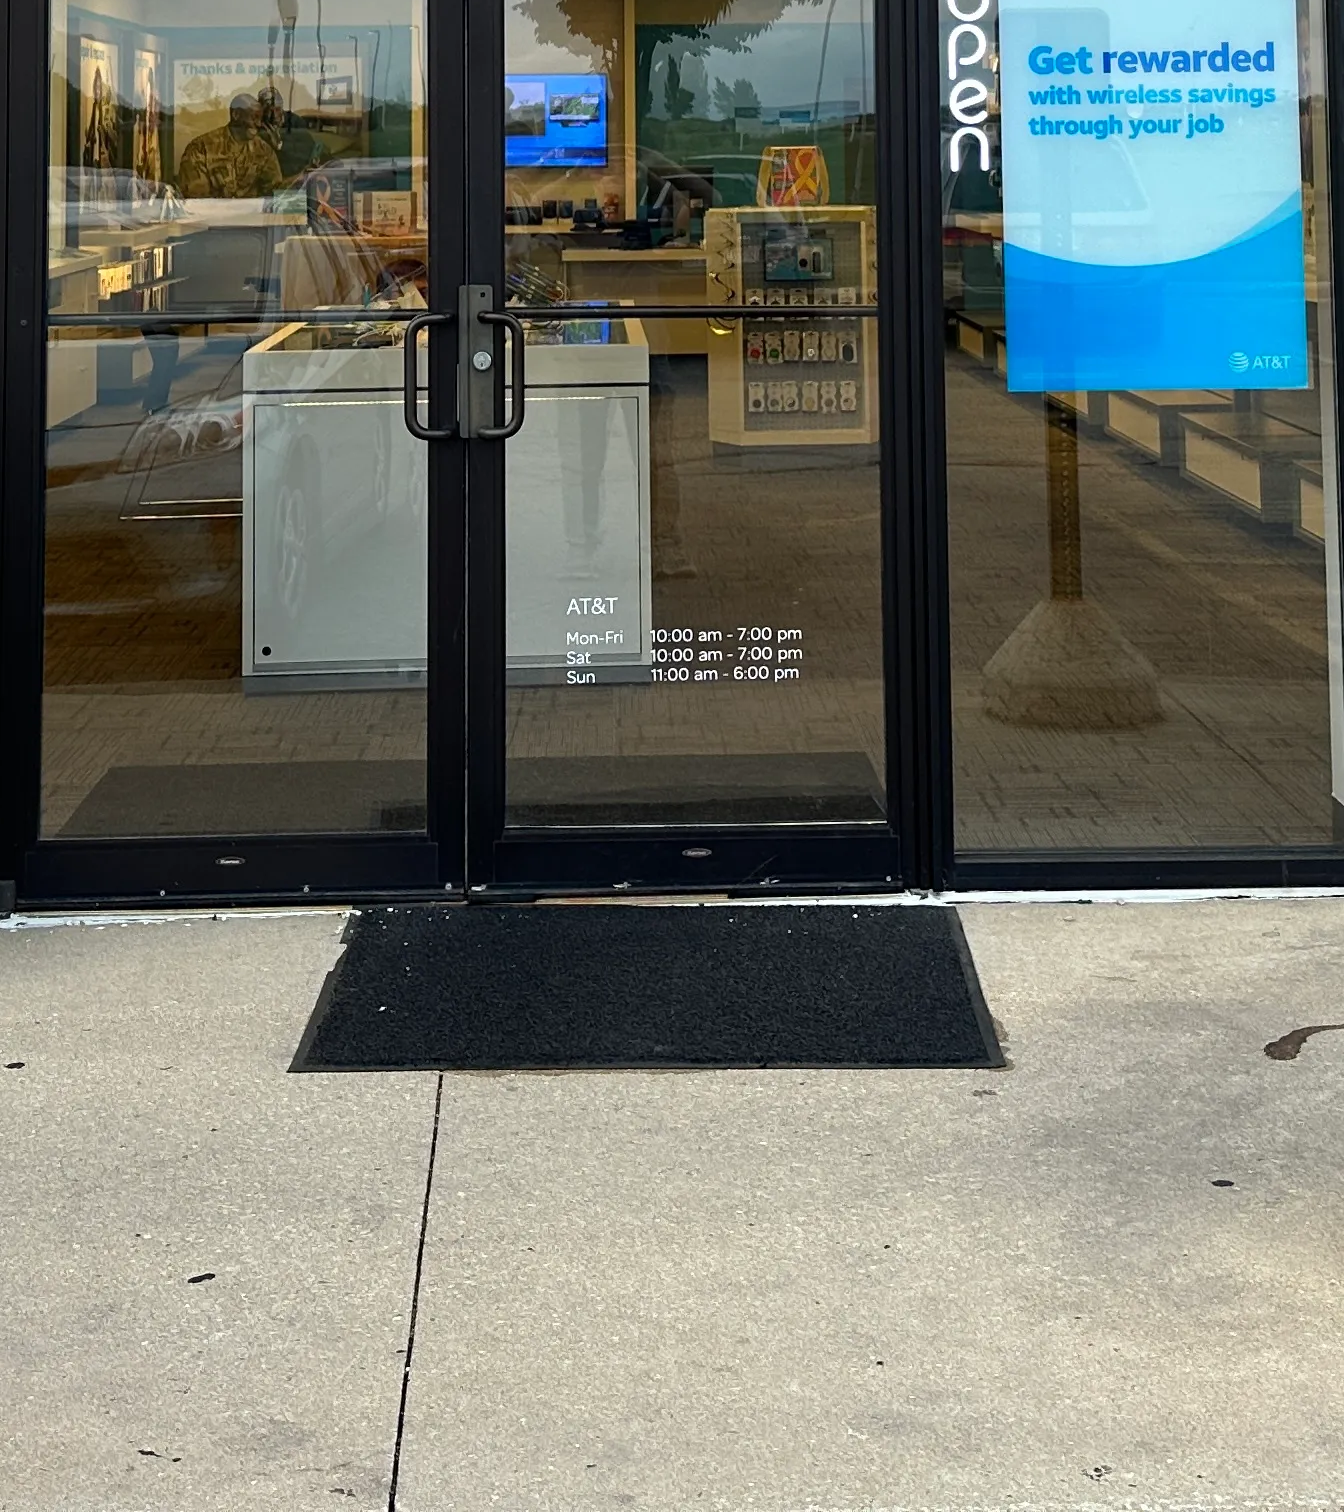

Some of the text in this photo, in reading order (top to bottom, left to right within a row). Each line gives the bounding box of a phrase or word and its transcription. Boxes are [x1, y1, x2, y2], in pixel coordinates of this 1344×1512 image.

[1028, 41, 1275, 75] Get rewarded
[181, 62, 232, 75] Thanks
[1028, 82, 1276, 108] with wireless savings
[1028, 113, 1225, 139] through your job
[1252, 355, 1292, 370] AT&T
[566, 597, 618, 616] AT&T
[566, 630, 624, 646] Mon-Fri
[650, 628, 693, 644] 10:00
[698, 631, 722, 642] am
[737, 627, 772, 642] 7:00
[777, 628, 802, 644] pm
[566, 651, 591, 665] Sat
[650, 648, 694, 663] 10:00
[698, 651, 722, 662] am
[737, 647, 773, 662] 7:00
[777, 648, 803, 664] pm
[566, 670, 596, 685] Sun
[651, 667, 689, 683] 11:00
[694, 670, 718, 681] am
[733, 666, 769, 681] 6:00
[774, 667, 800, 683] pm
